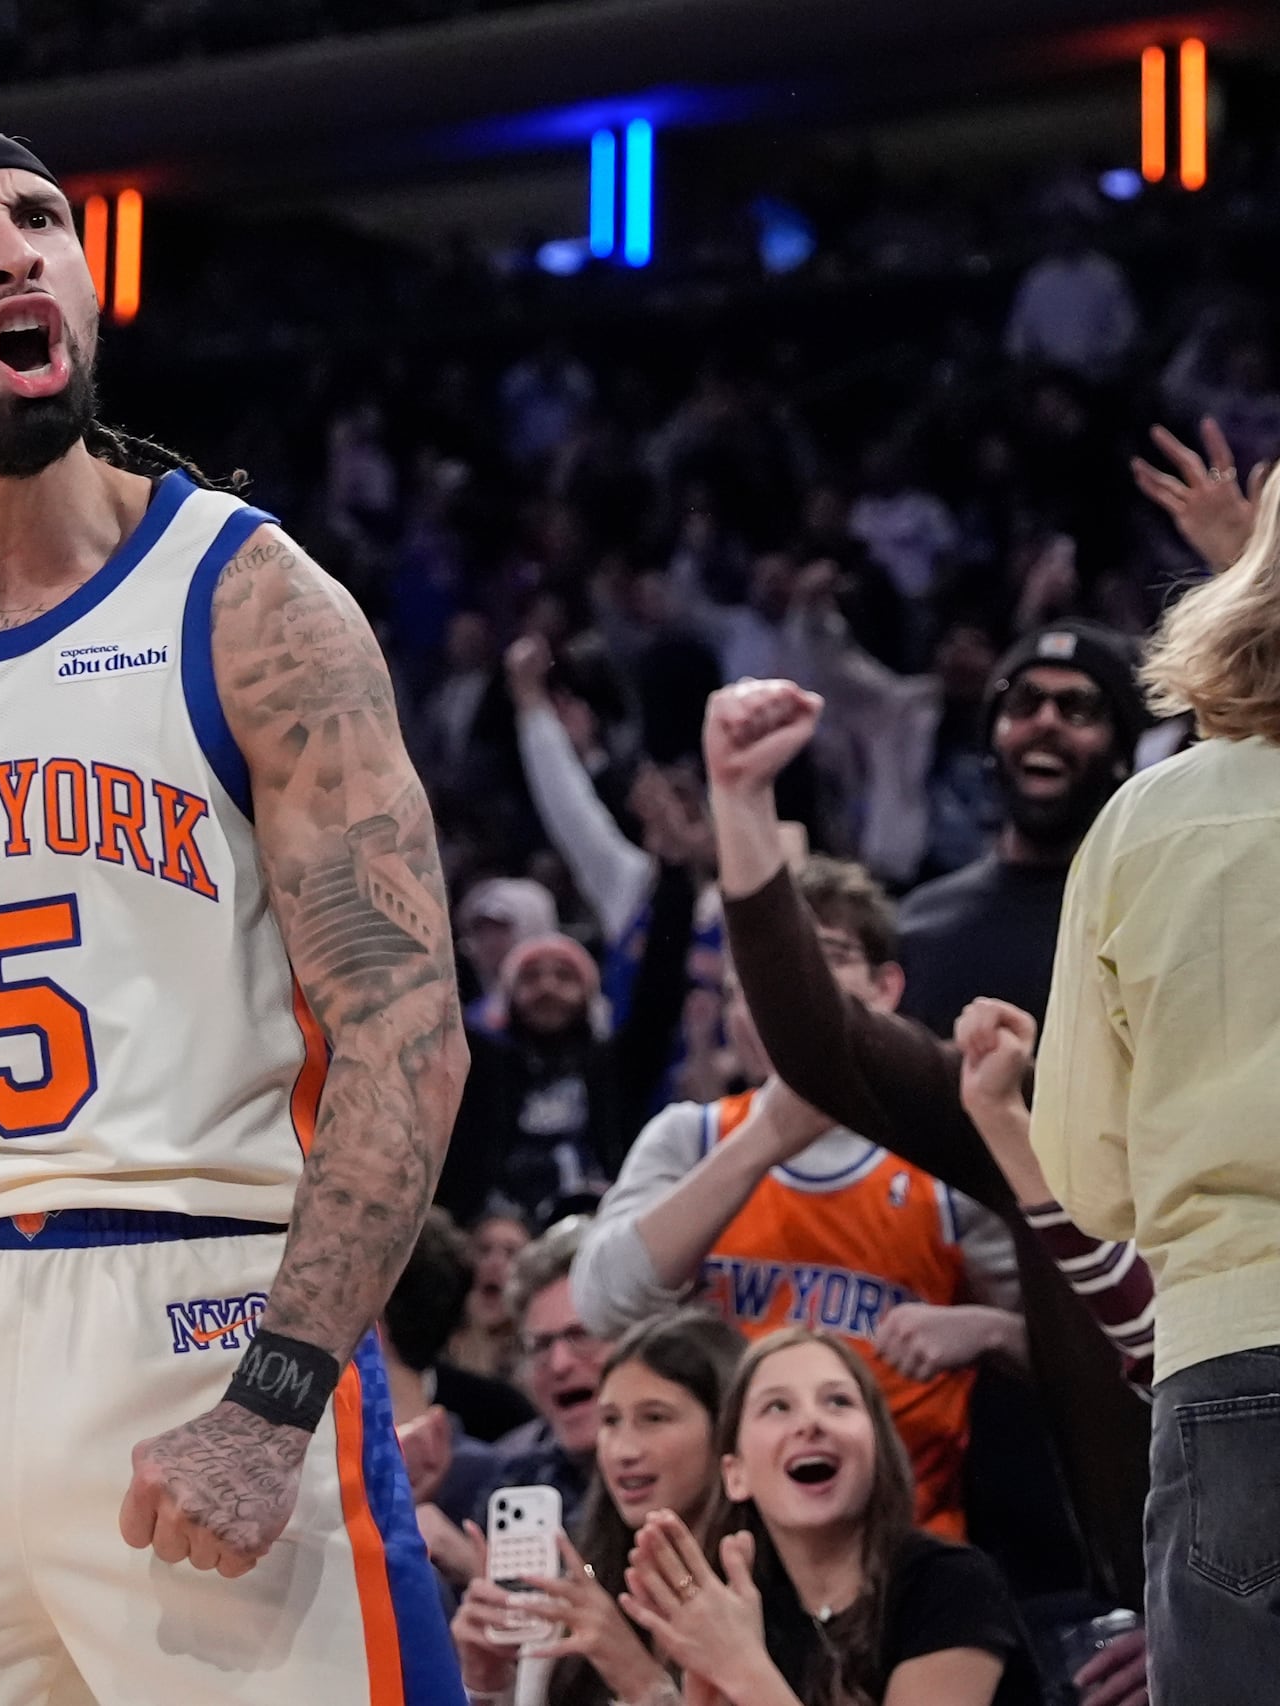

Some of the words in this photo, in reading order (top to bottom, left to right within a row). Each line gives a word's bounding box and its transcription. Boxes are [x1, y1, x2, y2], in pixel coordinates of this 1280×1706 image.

[58, 658, 100, 677] abu
[105, 645, 168, 671] dhabi
[60, 645, 119, 658] experience
[793, 1268, 903, 1332] YOR
[238, 1344, 313, 1408] MOM
